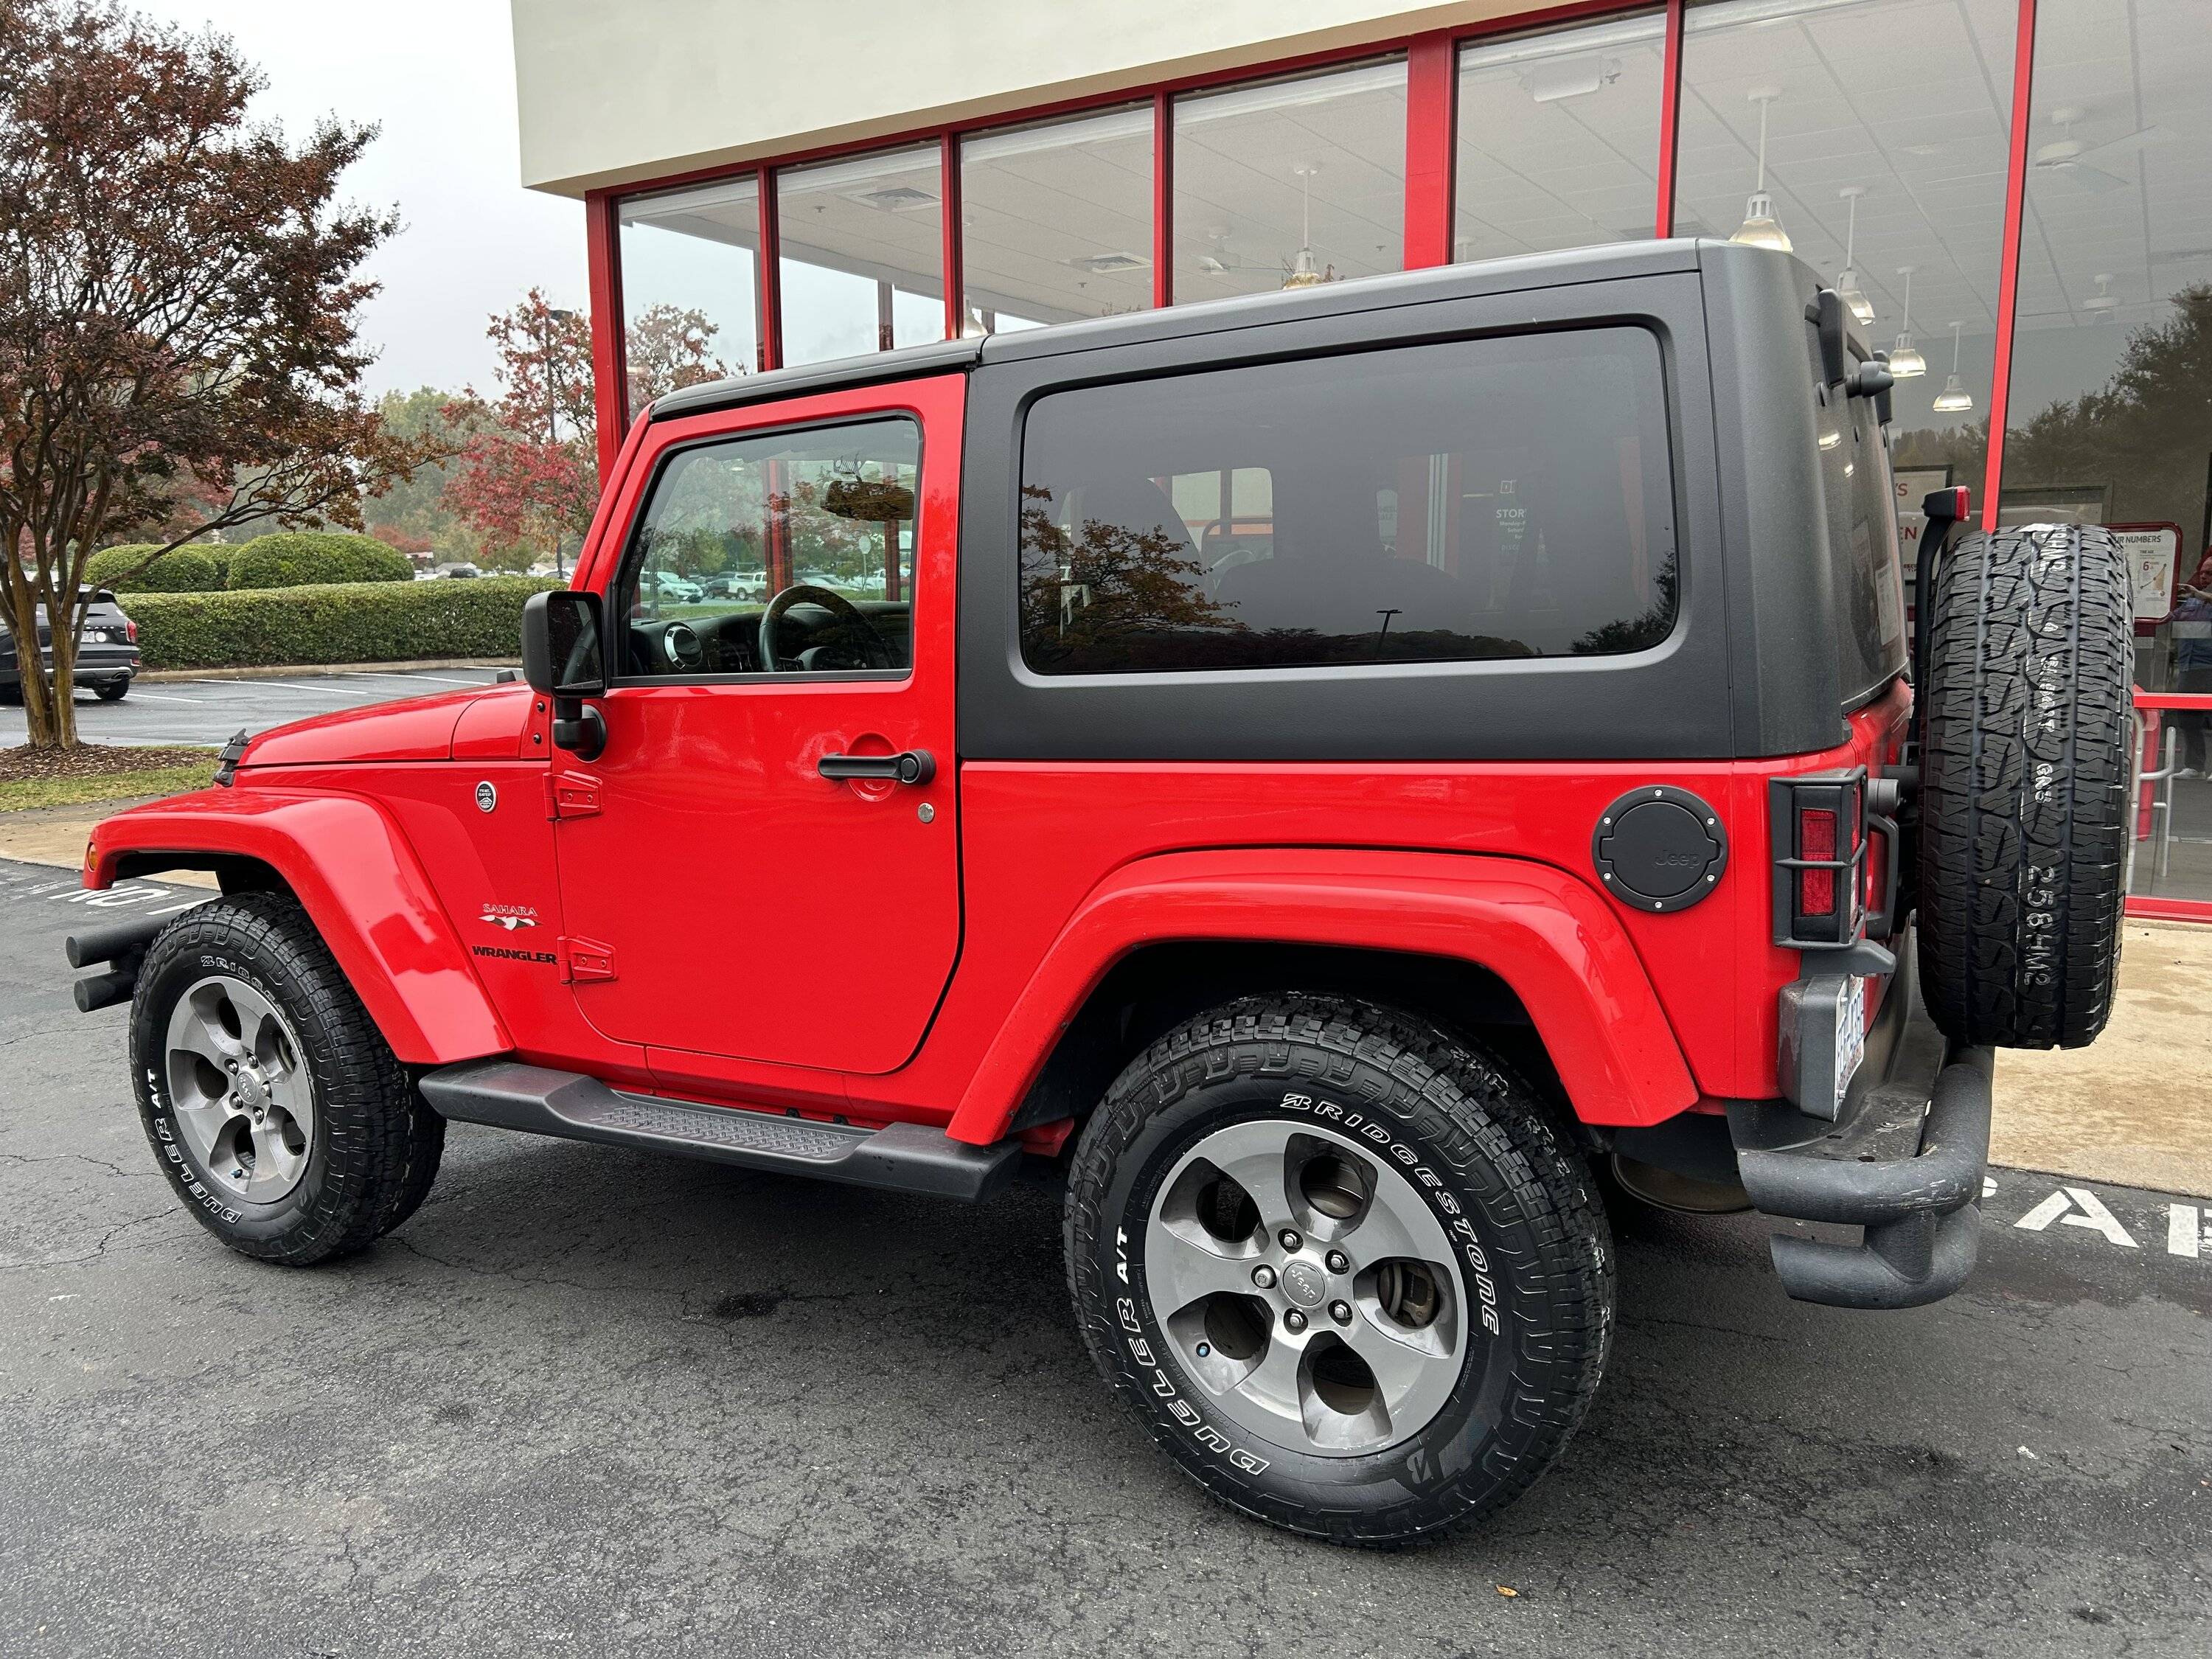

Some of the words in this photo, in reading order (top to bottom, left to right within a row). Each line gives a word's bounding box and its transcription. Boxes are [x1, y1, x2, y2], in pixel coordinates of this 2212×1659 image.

[2125, 535, 2162, 543] NUMBERS
[483, 903, 538, 917] SAHARA
[472, 945, 558, 966] WRANGLER
[155, 1118, 244, 1223] DUELER
[1280, 1093, 1500, 1336] BRIDGESTONE
[1116, 1225, 1130, 1285] A/T
[1291, 1269, 1316, 1298] Jeep
[1116, 1296, 1271, 1475] DUELER
